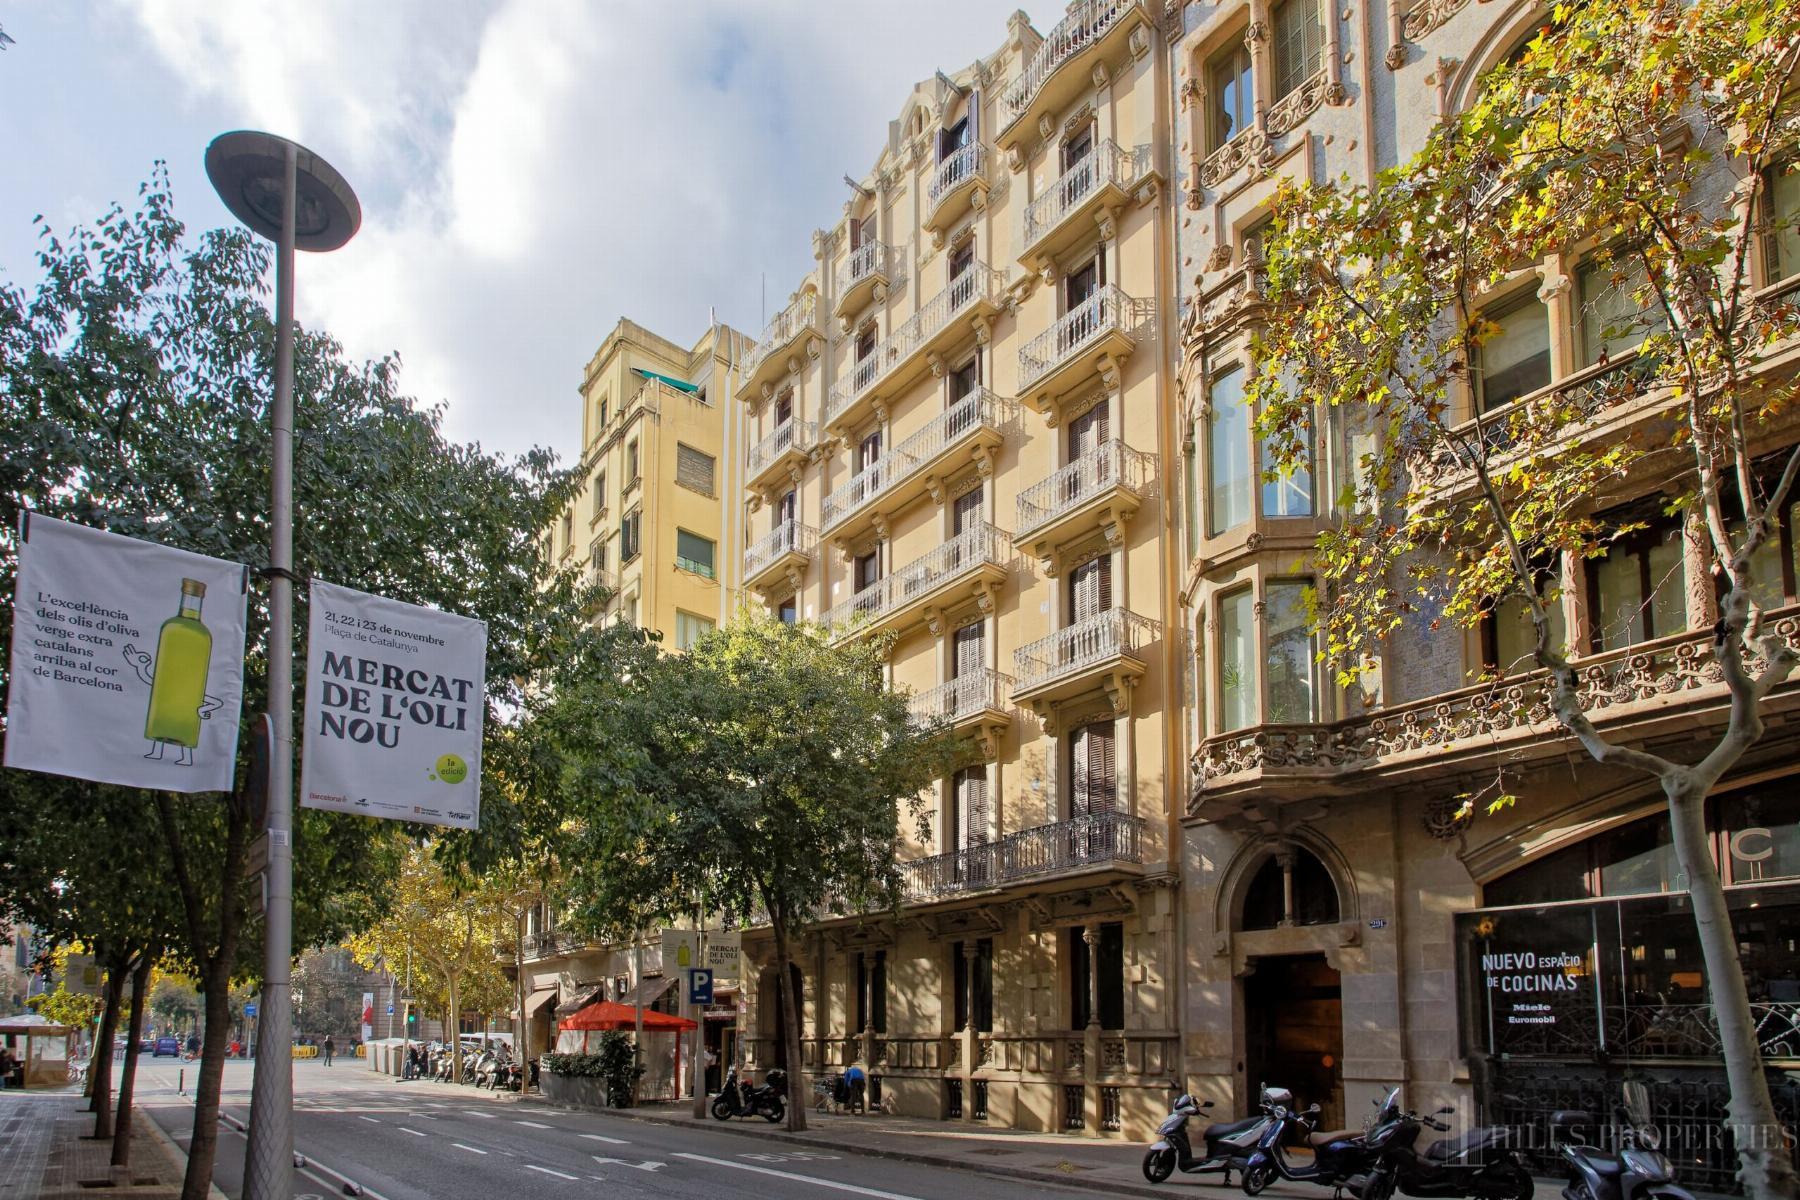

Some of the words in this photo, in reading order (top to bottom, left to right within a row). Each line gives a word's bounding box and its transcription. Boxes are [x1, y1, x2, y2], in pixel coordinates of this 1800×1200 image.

[36, 607, 66, 622] dels
[68, 615, 93, 628] olis
[95, 620, 140, 638] d'oliva
[324, 611, 338, 624] 21,
[340, 615, 355, 627] 22
[357, 618, 361, 628] i
[362, 620, 377, 631] 23
[379, 624, 392, 635] de
[394, 629, 446, 647] novembre
[35, 624, 75, 639] verge
[78, 633, 113, 647] extra
[324, 623, 352, 639] Plaça
[353, 632, 367, 642] de
[368, 634, 419, 653] Catalunya
[34, 638, 94, 657] catalans
[33, 653, 76, 669] arriba
[79, 661, 92, 672] al
[94, 665, 118, 676] cor
[33, 665, 50, 678] de
[53, 669, 123, 692] Barcelona
[321, 650, 474, 704] MERCAT
[321, 680, 371, 715] DE
[381, 693, 467, 731] L'OLI
[319, 710, 401, 749] NOU
[1482, 952, 1535, 971] NUEVO
[1538, 955, 1581, 968] ESPACIO
[693, 971, 709, 992] P
[1486, 976, 1499, 988] DE
[1501, 973, 1578, 993] COCINAS
[1512, 1003, 1552, 1012] Miele
[1508, 1015, 1556, 1024] Euromobil
